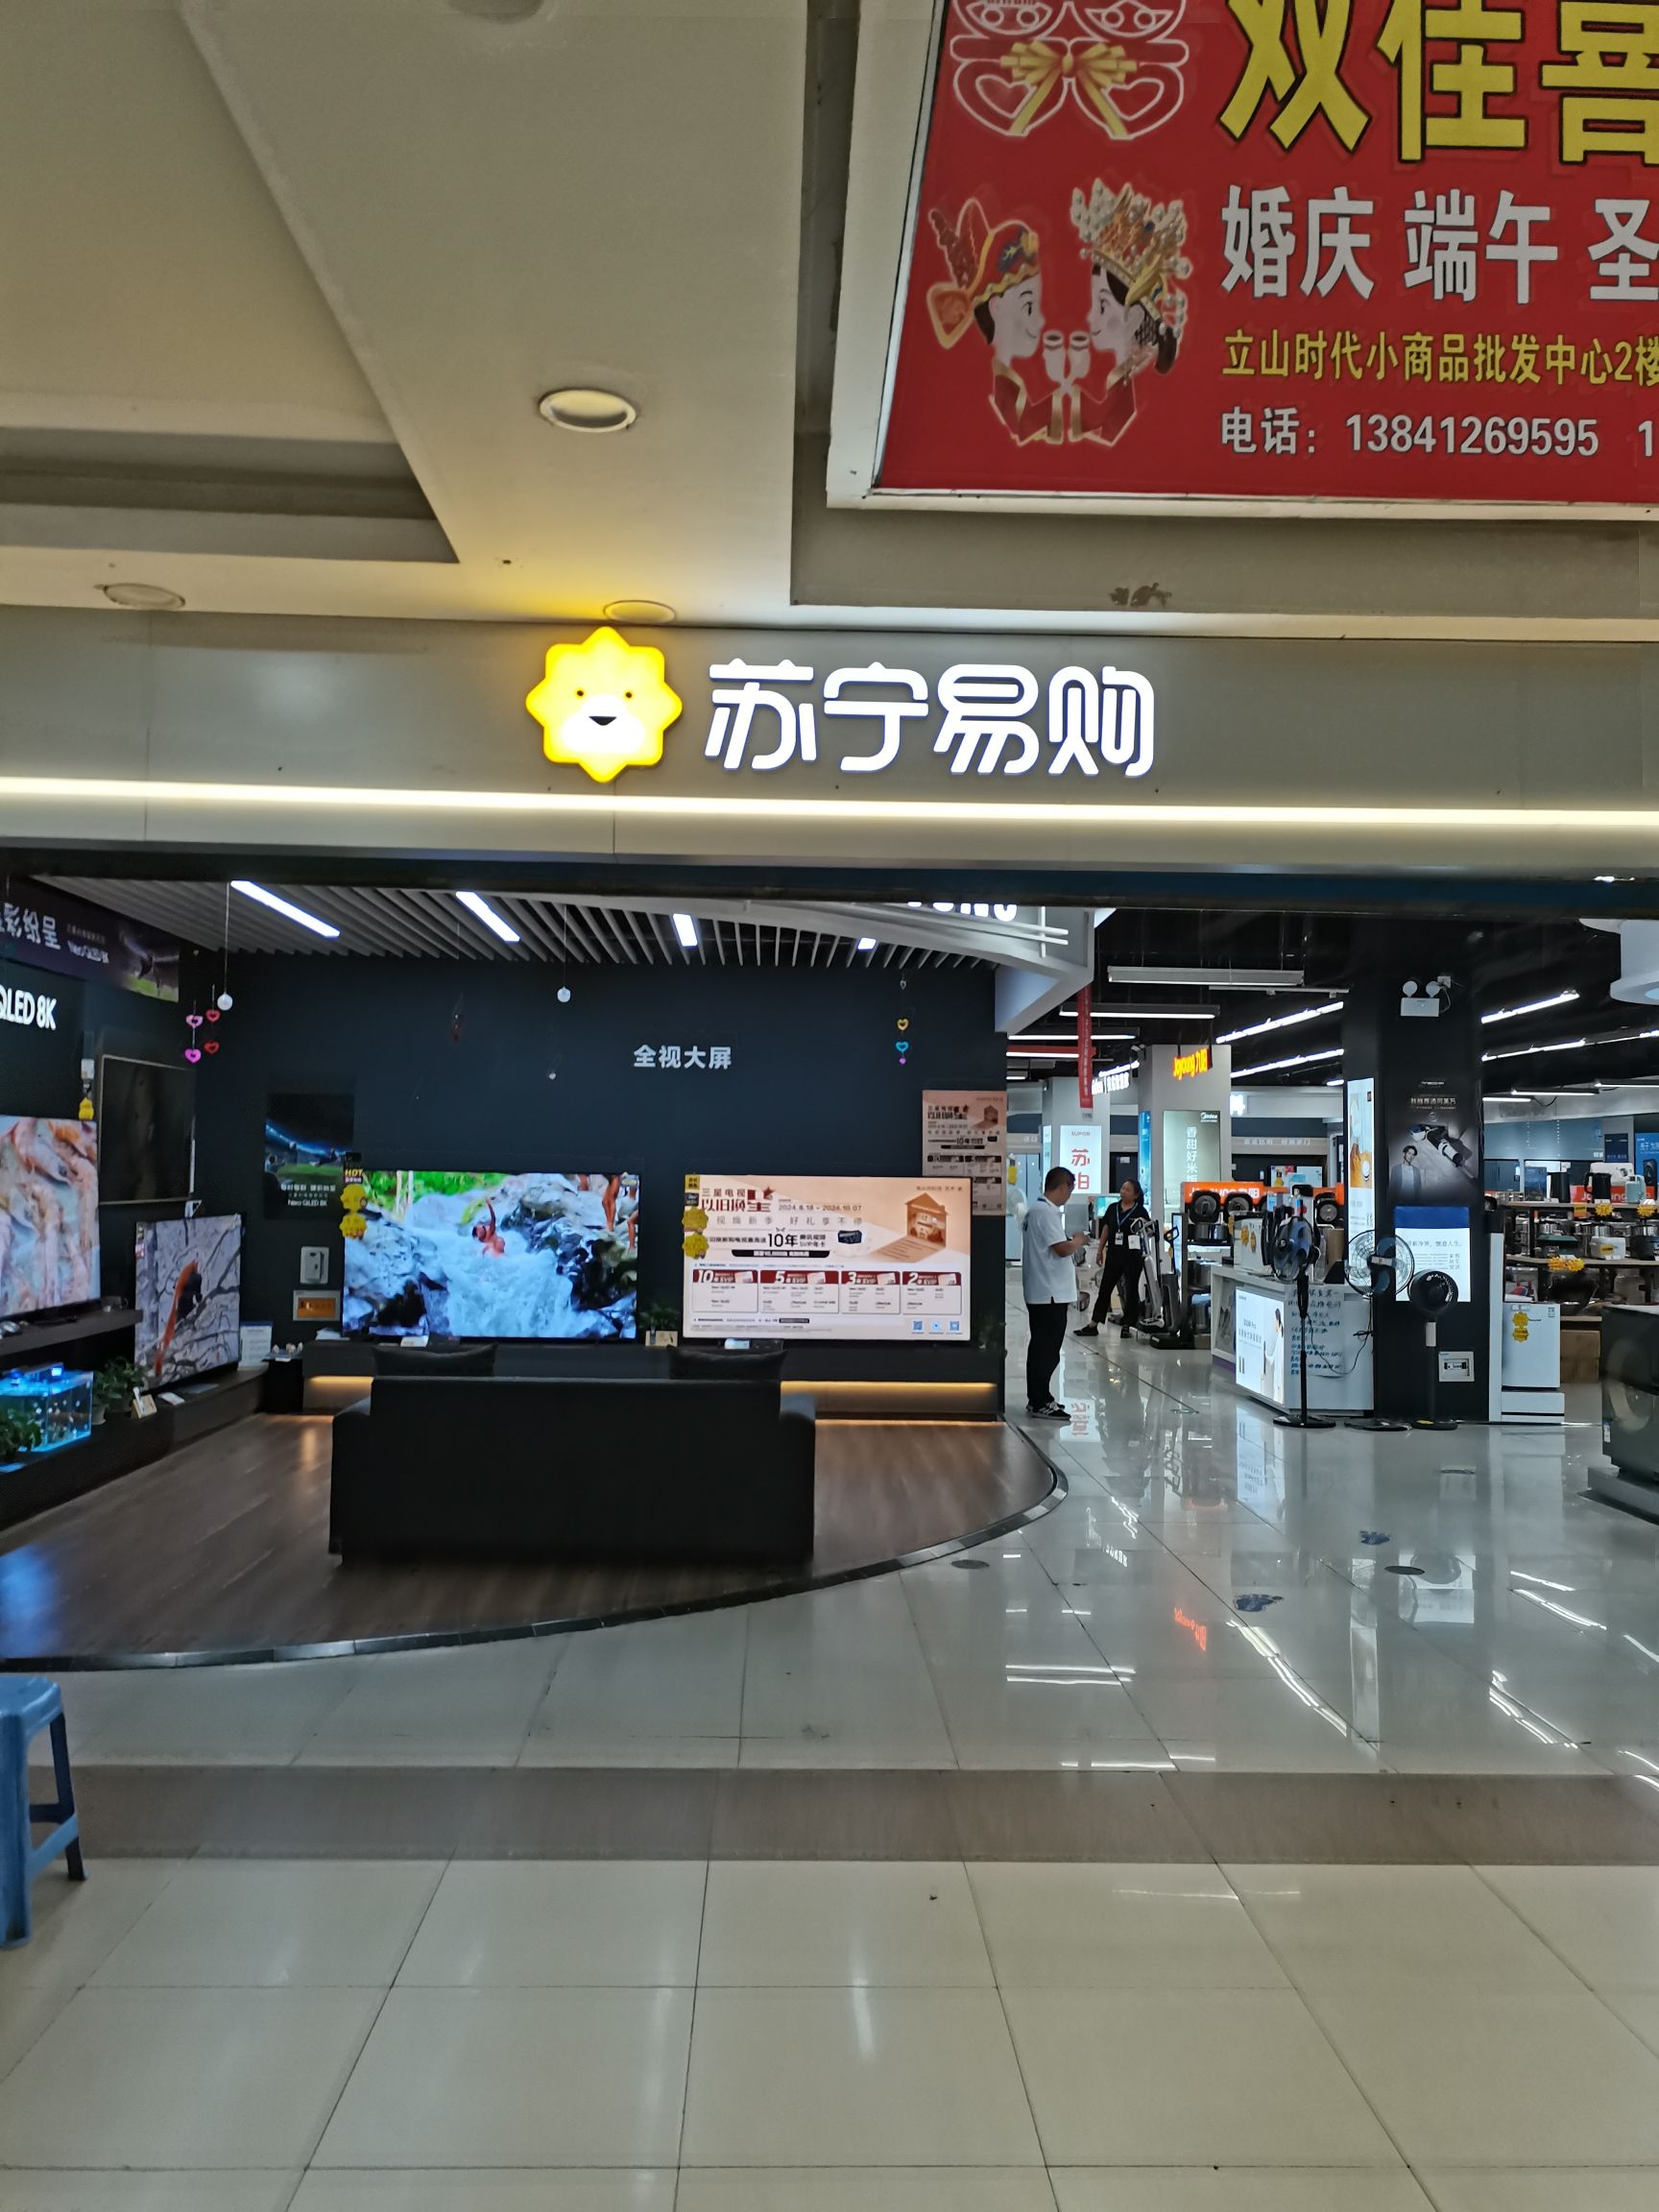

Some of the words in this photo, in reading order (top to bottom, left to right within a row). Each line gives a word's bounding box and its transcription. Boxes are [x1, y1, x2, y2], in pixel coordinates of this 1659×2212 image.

[1219, 183, 1375, 300] 婚庆
[1403, 188, 1558, 305] 端午
[1587, 197, 1659, 302] 圣
[1221, 328, 1659, 386] 立山时代小商品批发中心2楼
[1221, 405, 1315, 454] 电话：
[1345, 414, 1599, 457] 13841269595
[704, 658, 1154, 777] 苏宁易购
[0, 902, 60, 950] 彩纷呈
[36, 995, 57, 1030] 8K
[634, 1044, 732, 1070] 全视大屏
[345, 1168, 363, 1177] HOT
[701, 1188, 746, 1198] 三星电视
[698, 1269, 714, 1284] 10
[776, 1270, 785, 1285] 5
[847, 1272, 857, 1285] 3
[906, 1272, 919, 1286] 2
